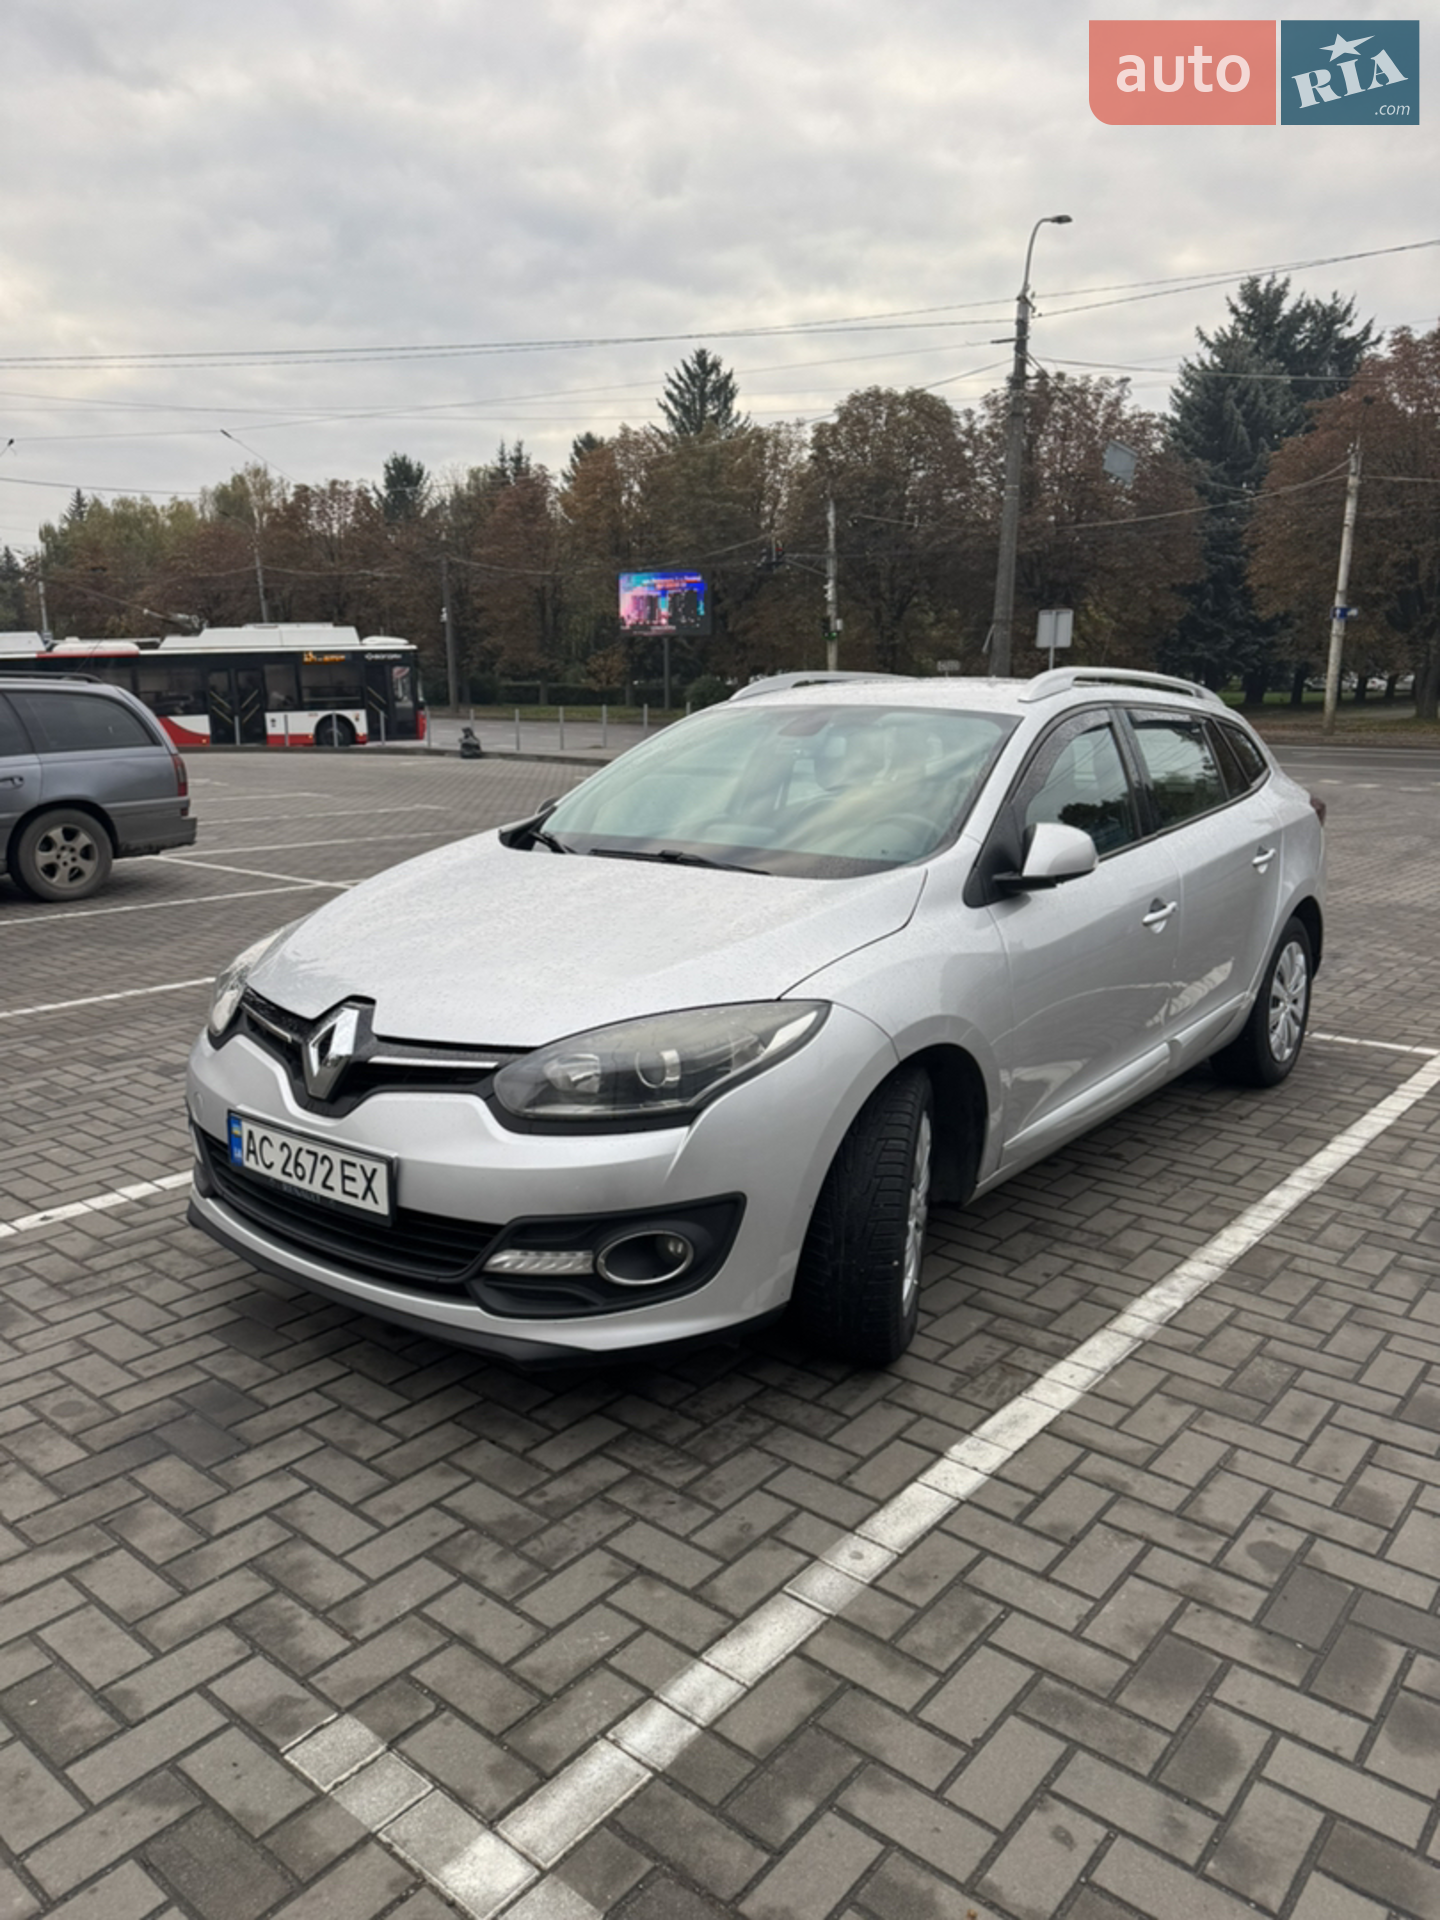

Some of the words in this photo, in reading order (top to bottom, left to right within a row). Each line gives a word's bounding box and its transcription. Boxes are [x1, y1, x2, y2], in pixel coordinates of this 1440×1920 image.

[245, 1129, 275, 1170] AC
[280, 1142, 335, 1192] 2672
[340, 1158, 379, 1205] EX
